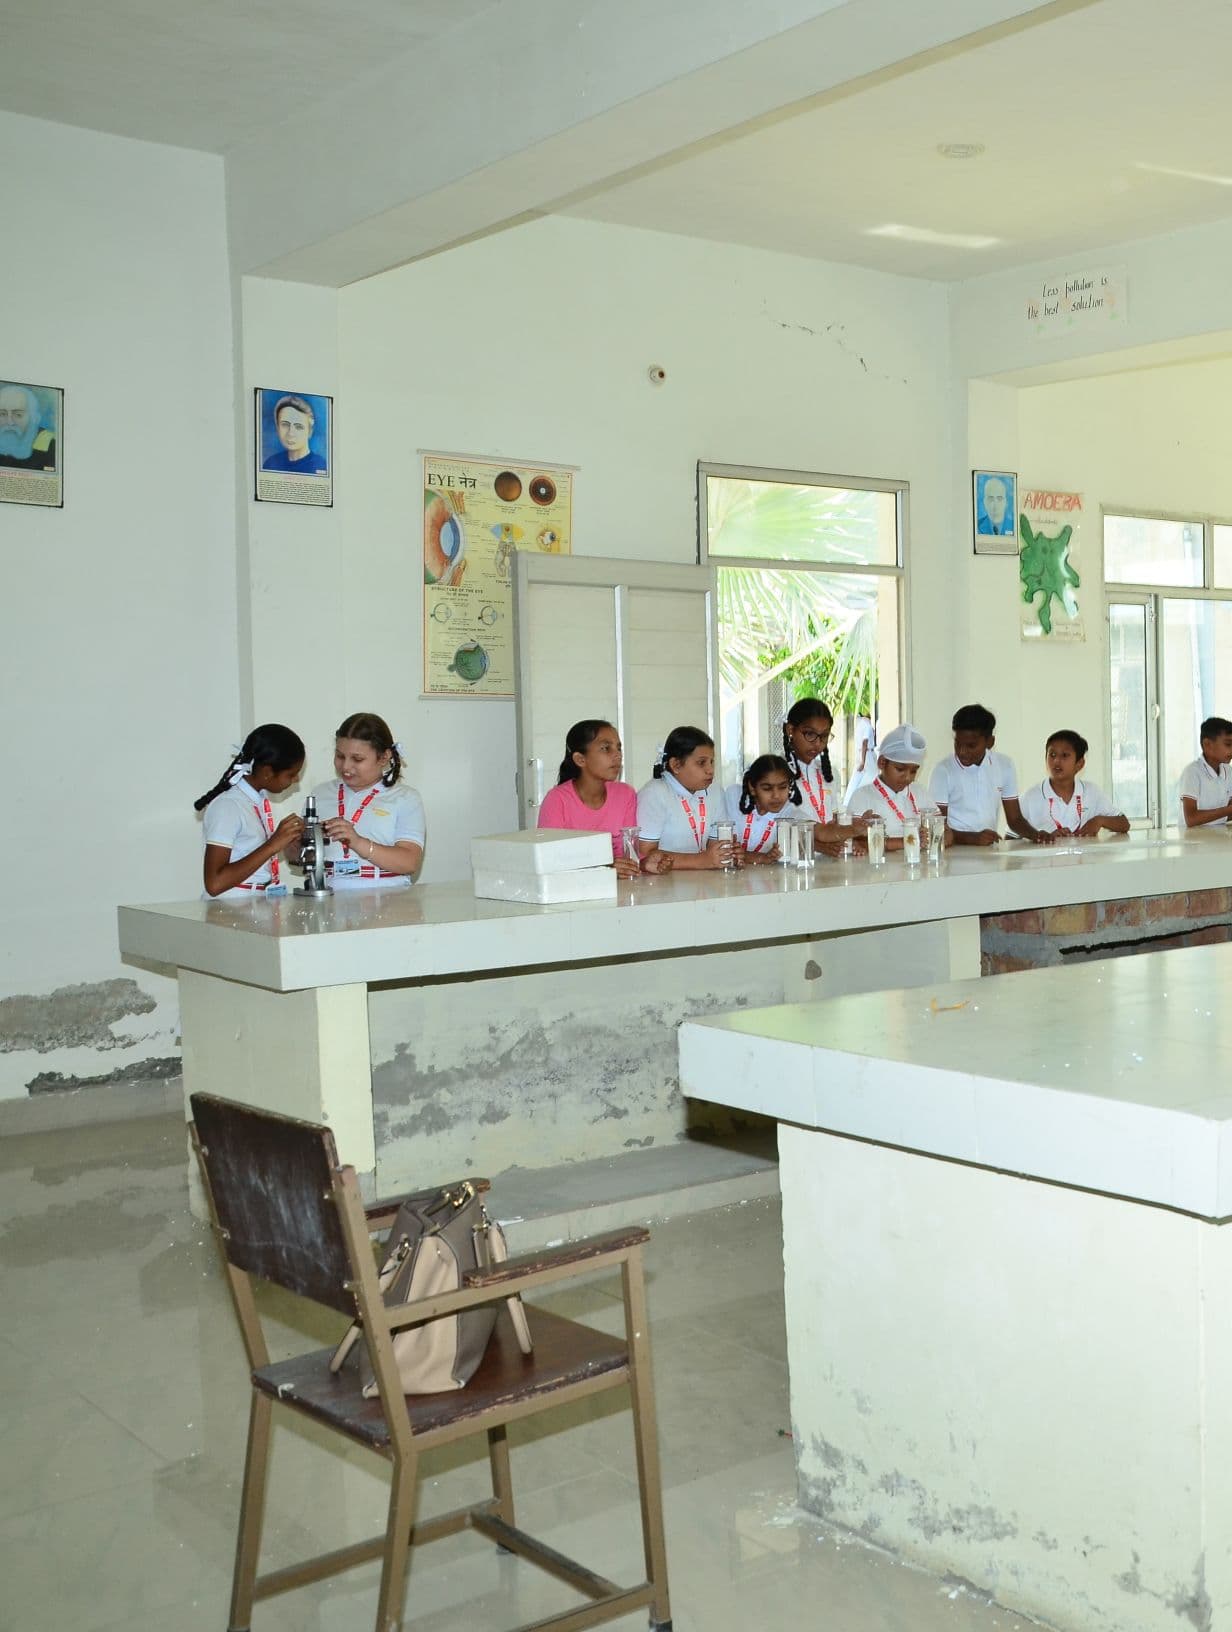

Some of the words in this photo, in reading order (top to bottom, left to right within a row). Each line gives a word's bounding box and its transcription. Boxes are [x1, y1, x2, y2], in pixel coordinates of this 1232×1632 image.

[1065, 278, 1094, 299] pollution
[1028, 305, 1039, 320] the
[1044, 301, 1059, 316] best
[1071, 294, 1104, 312] solution
[428, 473, 456, 487] EYE
[458, 472, 477, 488] नेत्र
[1023, 492, 1082, 512] AMOEBA
